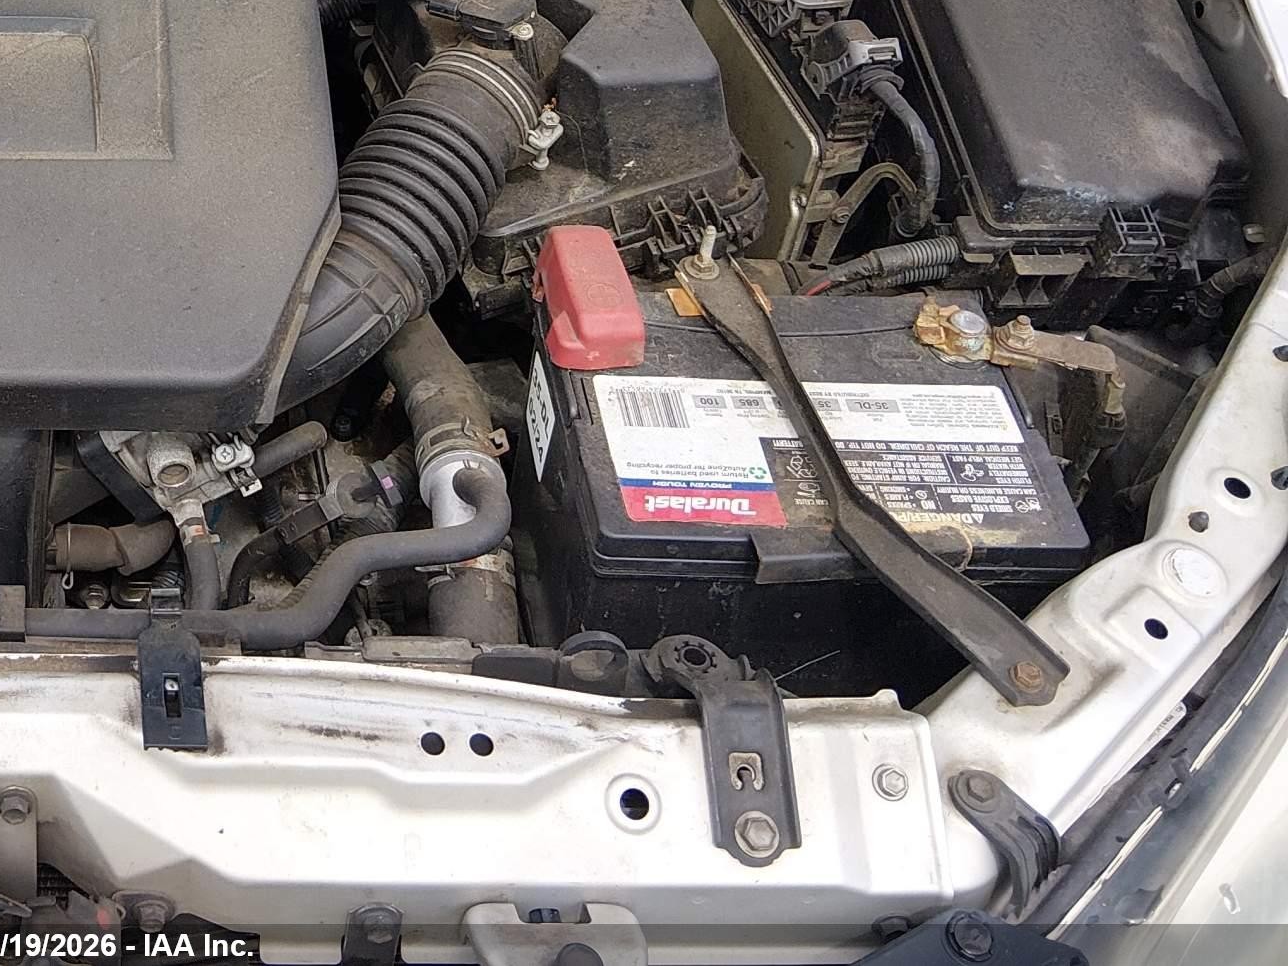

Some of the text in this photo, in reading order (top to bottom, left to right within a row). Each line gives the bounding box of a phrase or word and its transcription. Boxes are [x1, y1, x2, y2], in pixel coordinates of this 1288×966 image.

[699, 397, 720, 406] 100
[817, 400, 832, 408] 35
[854, 401, 889, 410] 35-DL
[985, 444, 1001, 452] OUT
[626, 461, 663, 469] recycling
[652, 480, 733, 489] PROVEN TOUGH
[644, 495, 758, 516] Duralast
[920, 500, 937, 510] NO
